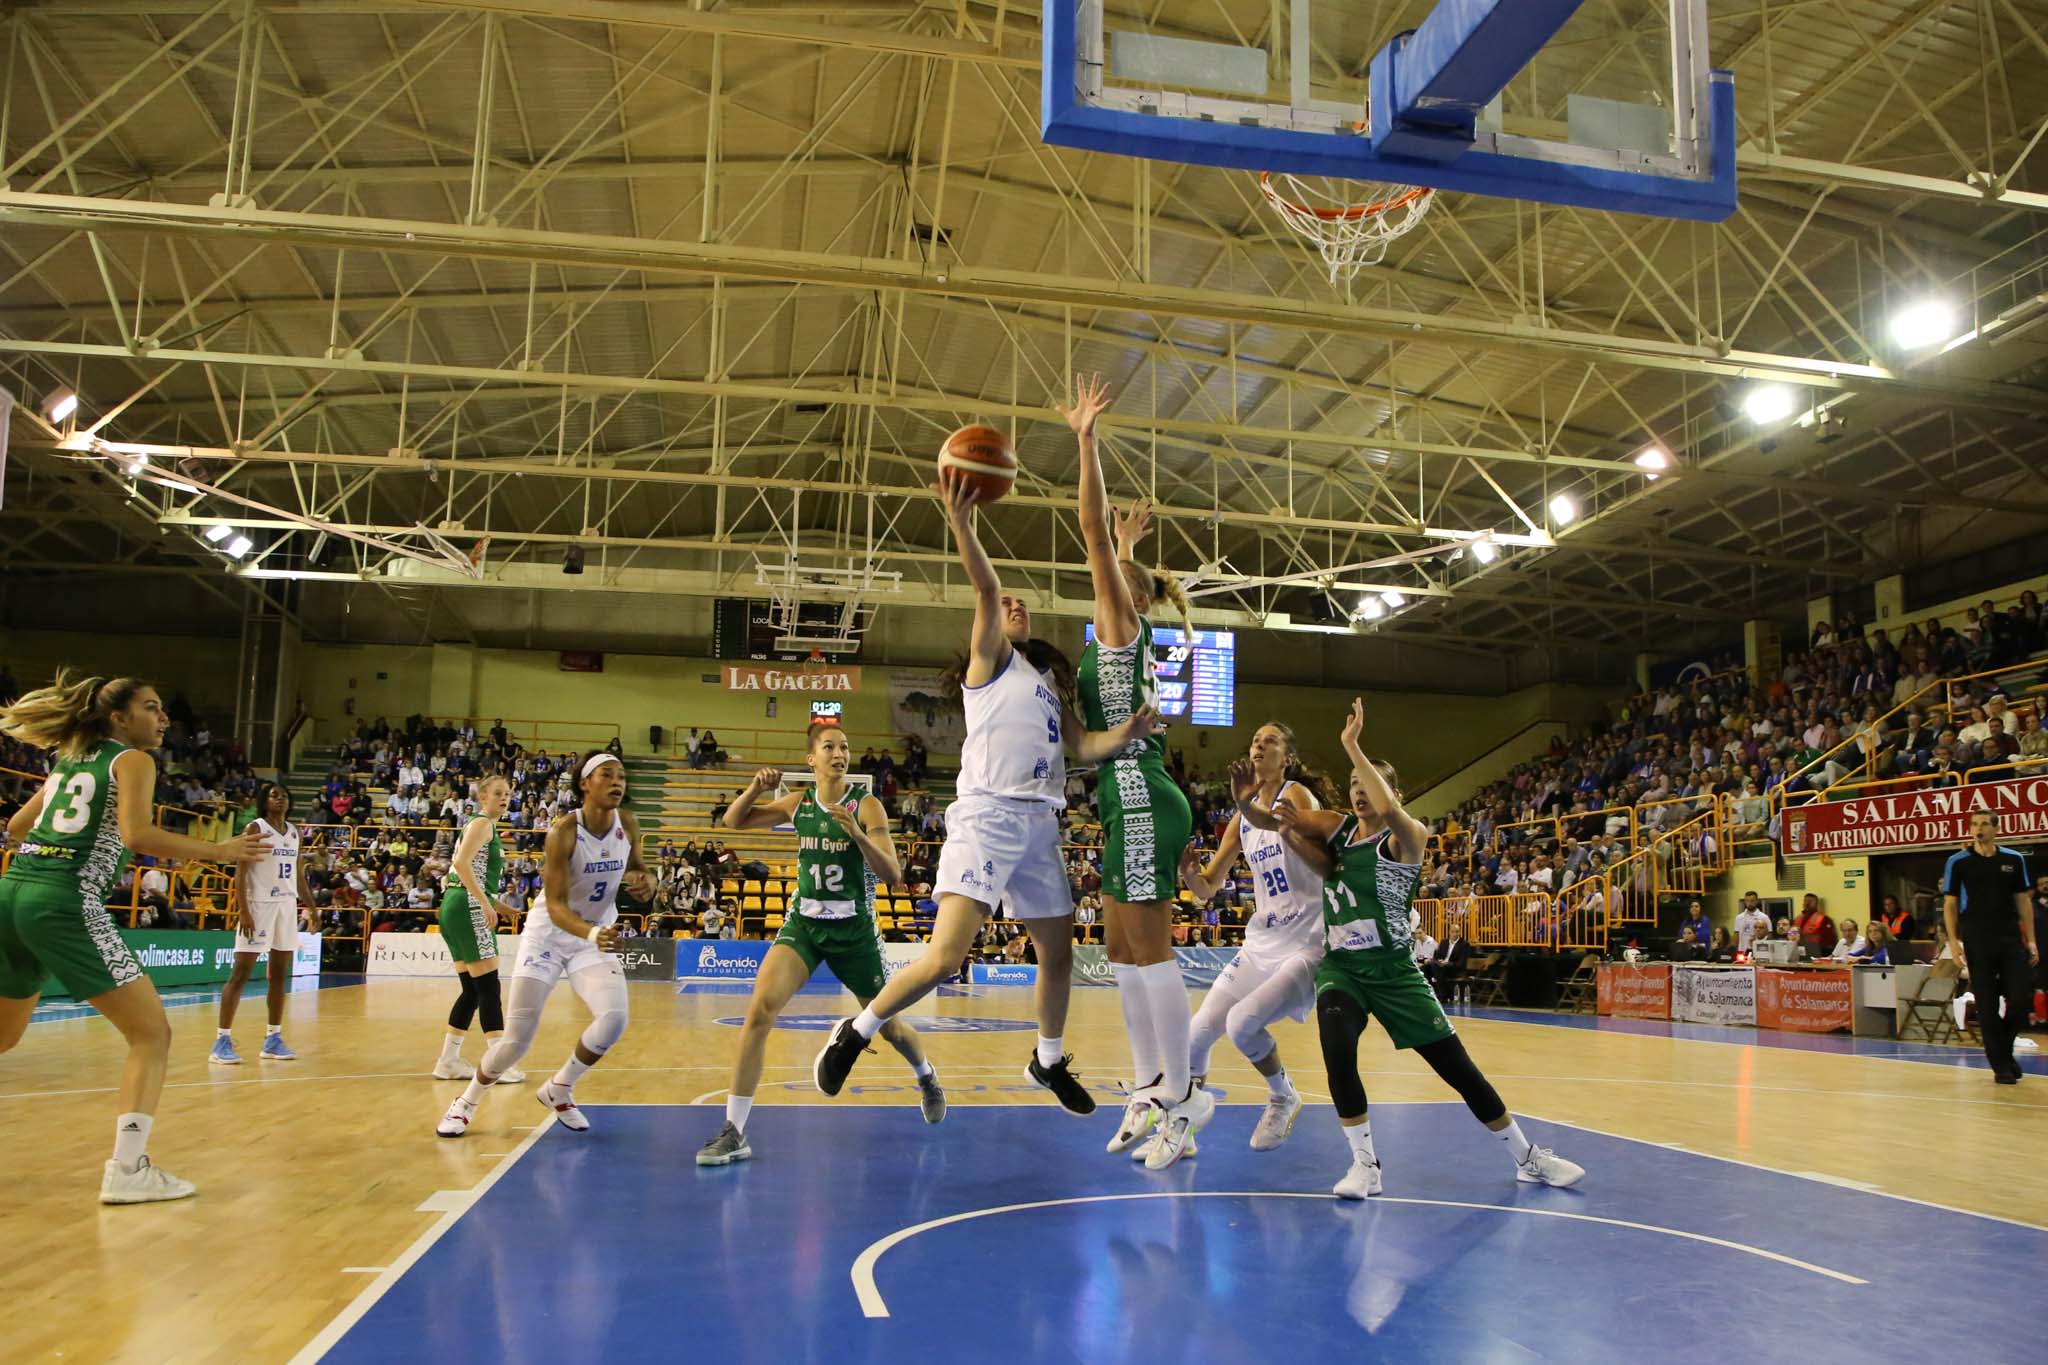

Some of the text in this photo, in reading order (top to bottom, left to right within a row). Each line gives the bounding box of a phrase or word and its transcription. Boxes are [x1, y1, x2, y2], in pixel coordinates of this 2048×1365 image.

[728, 668, 853, 691] LA GACETA
[1812, 823, 1919, 850] PATRIMONIO
[1923, 819, 1951, 841] DE
[278, 862, 292, 879] 12
[808, 863, 845, 892] 12
[588, 881, 608, 902] 3
[1262, 867, 1290, 897] 28
[374, 950, 450, 961] RIMME
[1780, 977, 1849, 993] Ayuntamiento
[1708, 991, 1753, 1008] Salamanca
[1782, 994, 1849, 1012] de Salamanca
